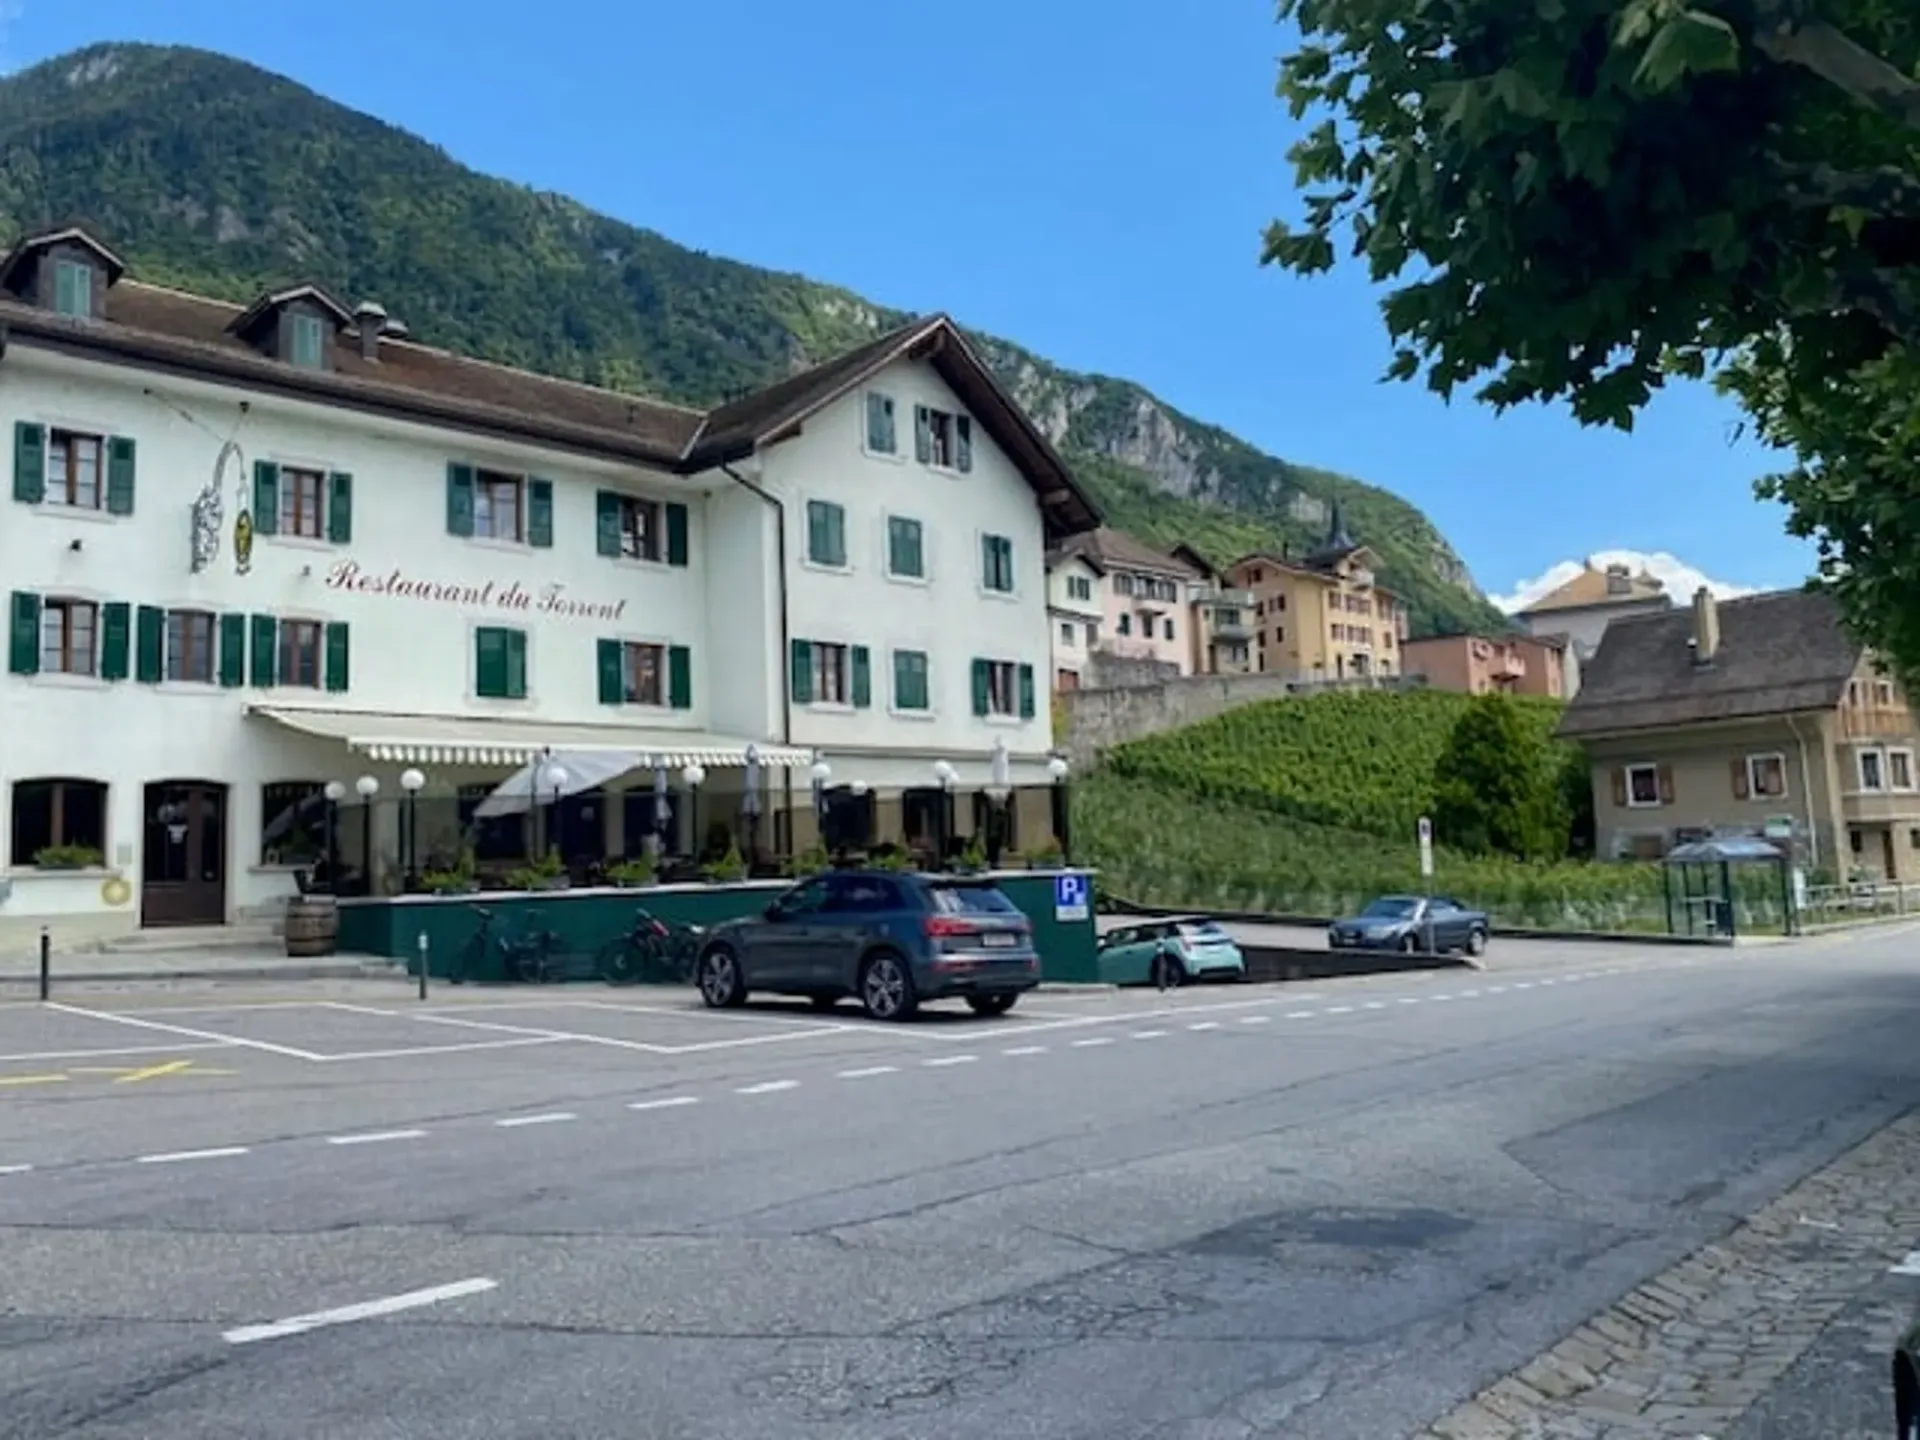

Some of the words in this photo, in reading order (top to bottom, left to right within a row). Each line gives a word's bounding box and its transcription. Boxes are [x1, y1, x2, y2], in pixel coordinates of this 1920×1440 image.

[325, 559, 494, 605] Restaurant
[497, 581, 530, 611] du
[537, 583, 626, 620] Torrent
[1062, 878, 1078, 902] P
